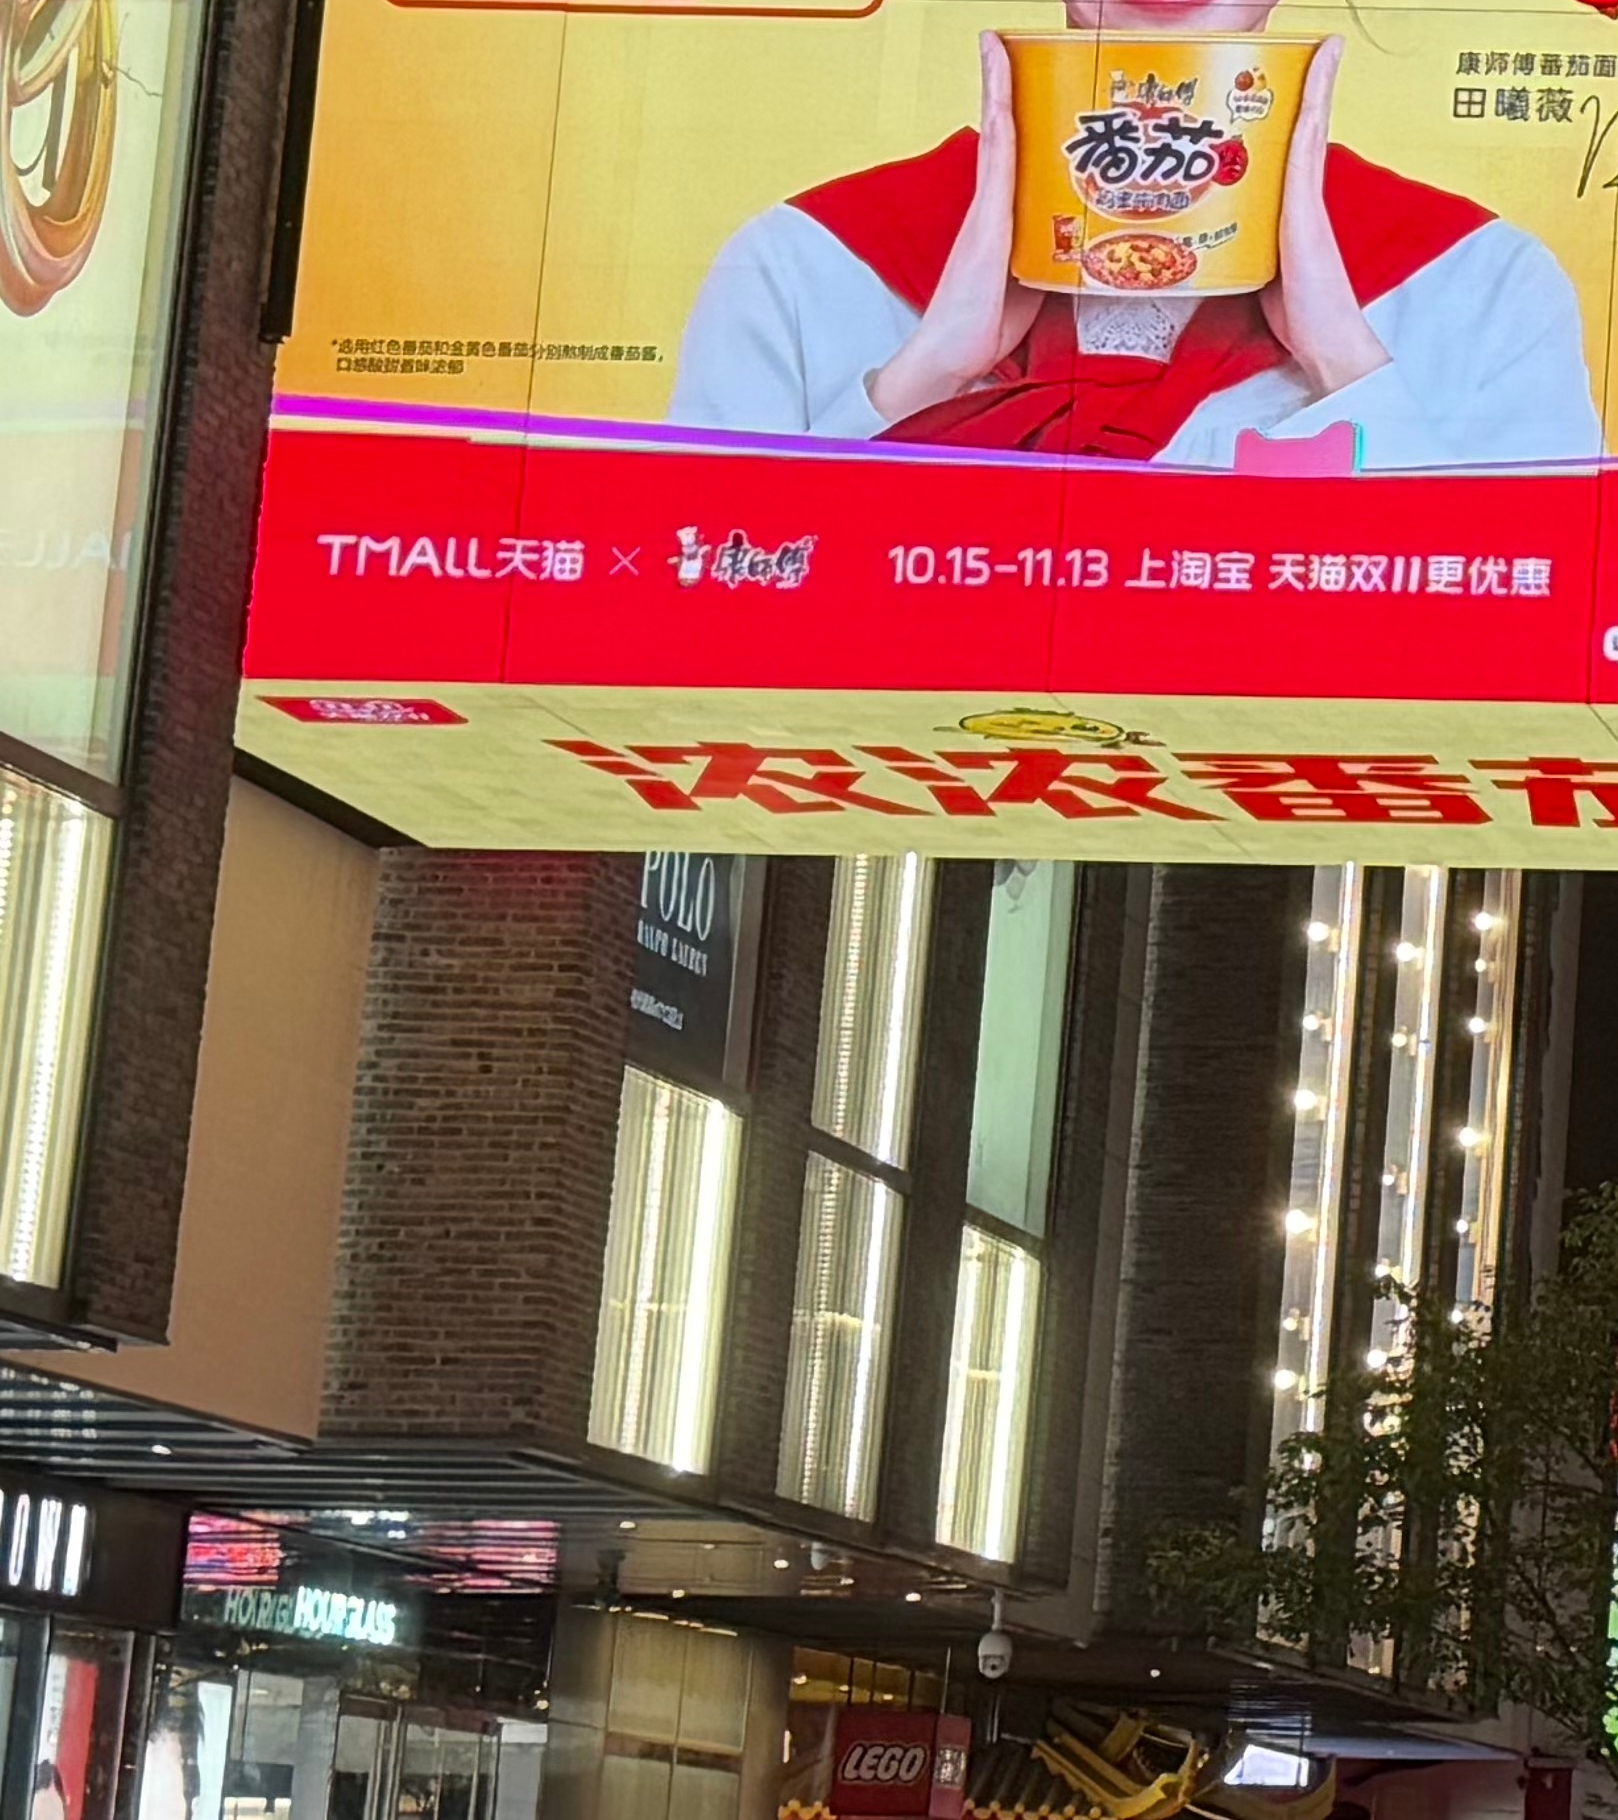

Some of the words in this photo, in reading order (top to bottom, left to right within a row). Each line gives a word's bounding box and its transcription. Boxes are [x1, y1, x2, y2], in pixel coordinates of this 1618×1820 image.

[1064, 111, 1225, 184] 番茄
[887, 543, 1109, 589] 10.15-11.13
[1124, 547, 1255, 593] 上淘宝
[1268, 553, 1552, 598] 天猫双11更优惠
[641, 851, 716, 942] POLO
[842, 1744, 926, 1782] LEGO
